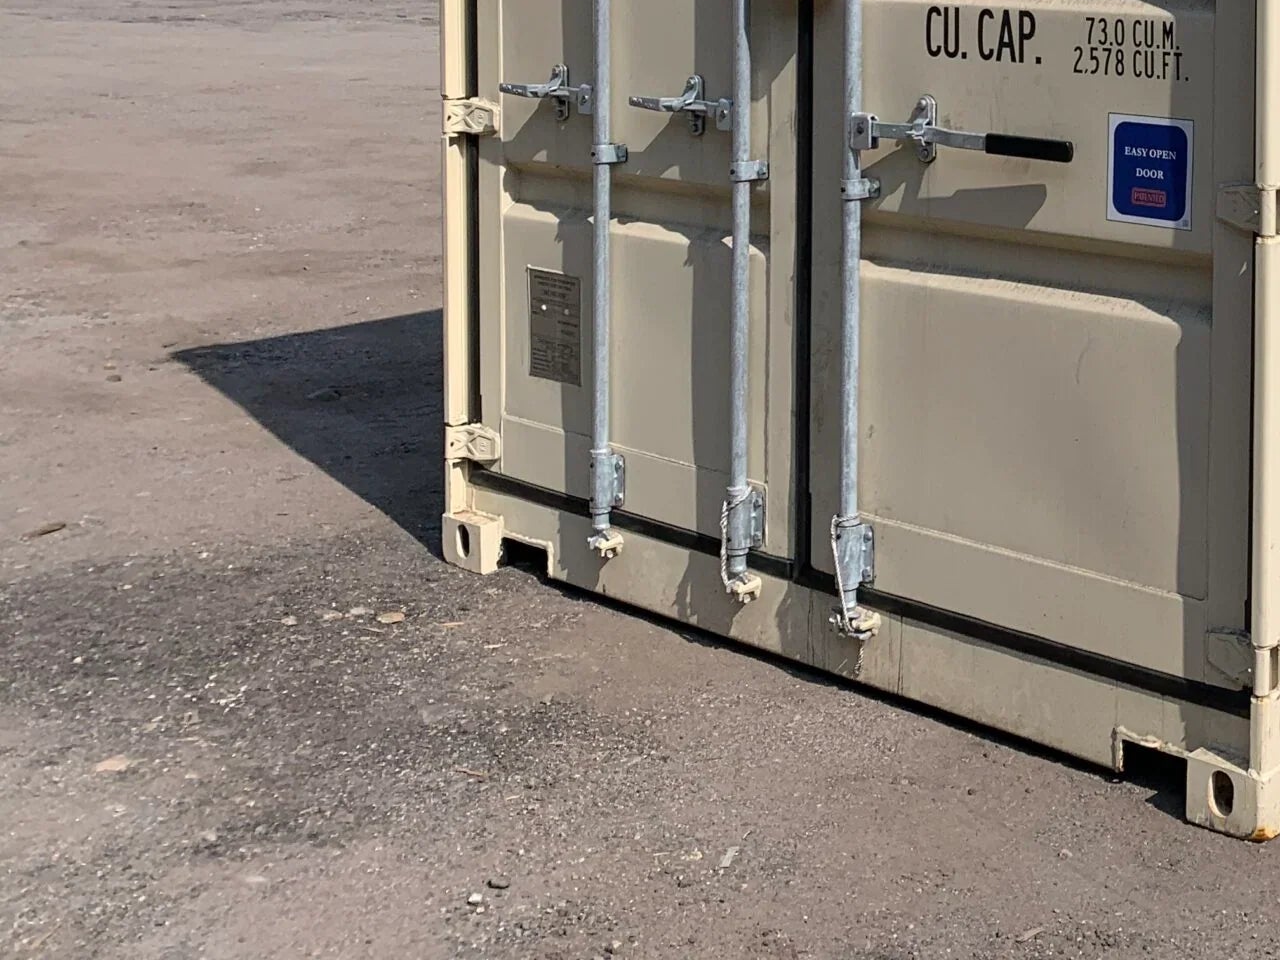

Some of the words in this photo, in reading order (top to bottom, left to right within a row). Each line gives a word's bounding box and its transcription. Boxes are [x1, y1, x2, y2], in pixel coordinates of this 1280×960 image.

[926, 6, 967, 59] CU.
[977, 8, 1042, 64] CAP.
[1086, 17, 1125, 47] 73.0
[1132, 20, 1180, 50] CU.M.
[1073, 46, 1125, 76] 2,578
[1132, 50, 1189, 82] CU.FT.
[1124, 146, 1148, 158] EASY
[1149, 148, 1177, 160] OPEN
[1135, 167, 1165, 180] DOOR
